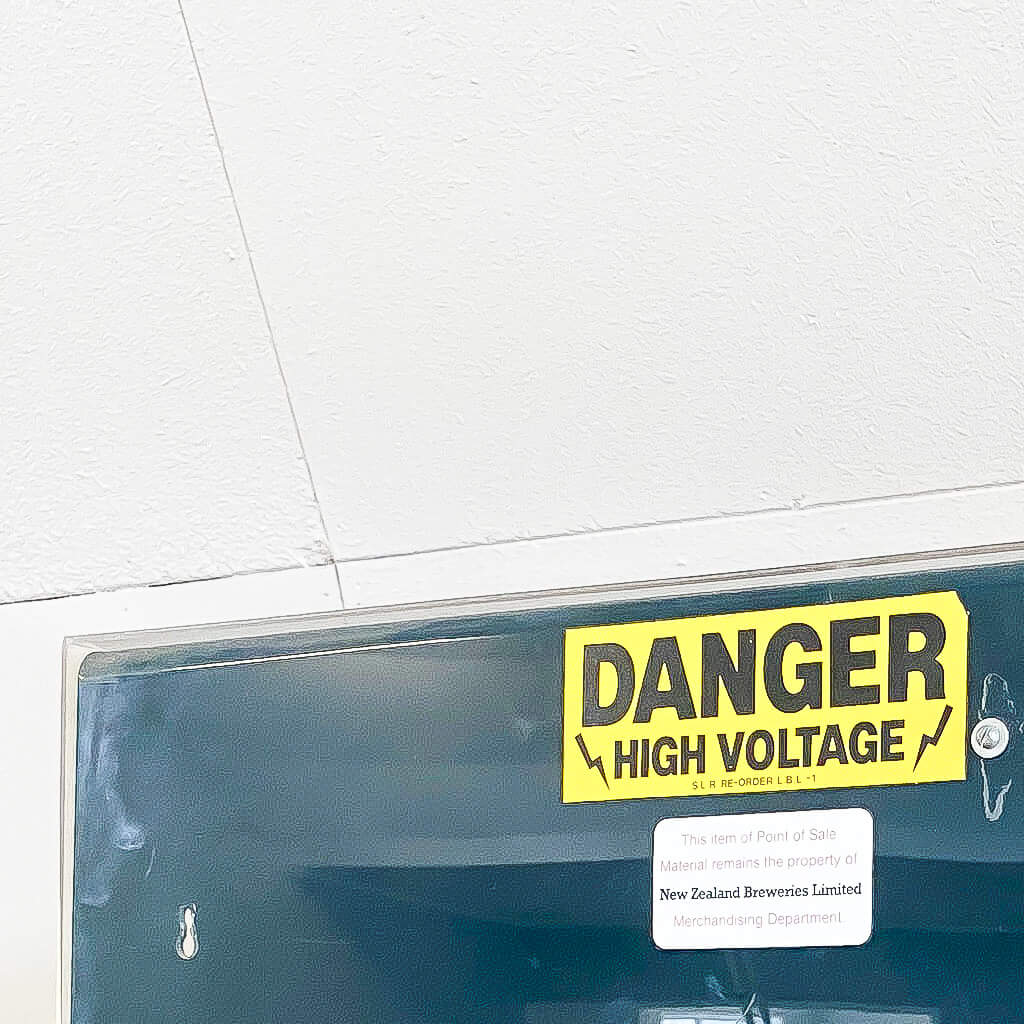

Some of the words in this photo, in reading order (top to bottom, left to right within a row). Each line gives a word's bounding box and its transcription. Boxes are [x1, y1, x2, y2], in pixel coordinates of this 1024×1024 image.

[582, 612, 946, 727] DANGER
[614, 733, 706, 779] HIGH
[718, 720, 906, 772] VOLTAGE
[721, 776, 773, 788] RE-ORDER
[681, 833, 707, 847] This
[711, 832, 737, 845] item
[740, 831, 753, 844] of
[757, 830, 788, 843] Point
[793, 829, 805, 842] of
[809, 828, 837, 841] Sale
[660, 858, 707, 872] Material
[712, 858, 760, 870] remains
[764, 856, 784, 869] the
[787, 854, 841, 871] property
[845, 853, 858, 865] of
[660, 888, 688, 901] New
[691, 886, 740, 899] Zealand
[744, 885, 809, 898] Breweries
[812, 883, 862, 897] Limited
[673, 913, 763, 928] Merchandising
